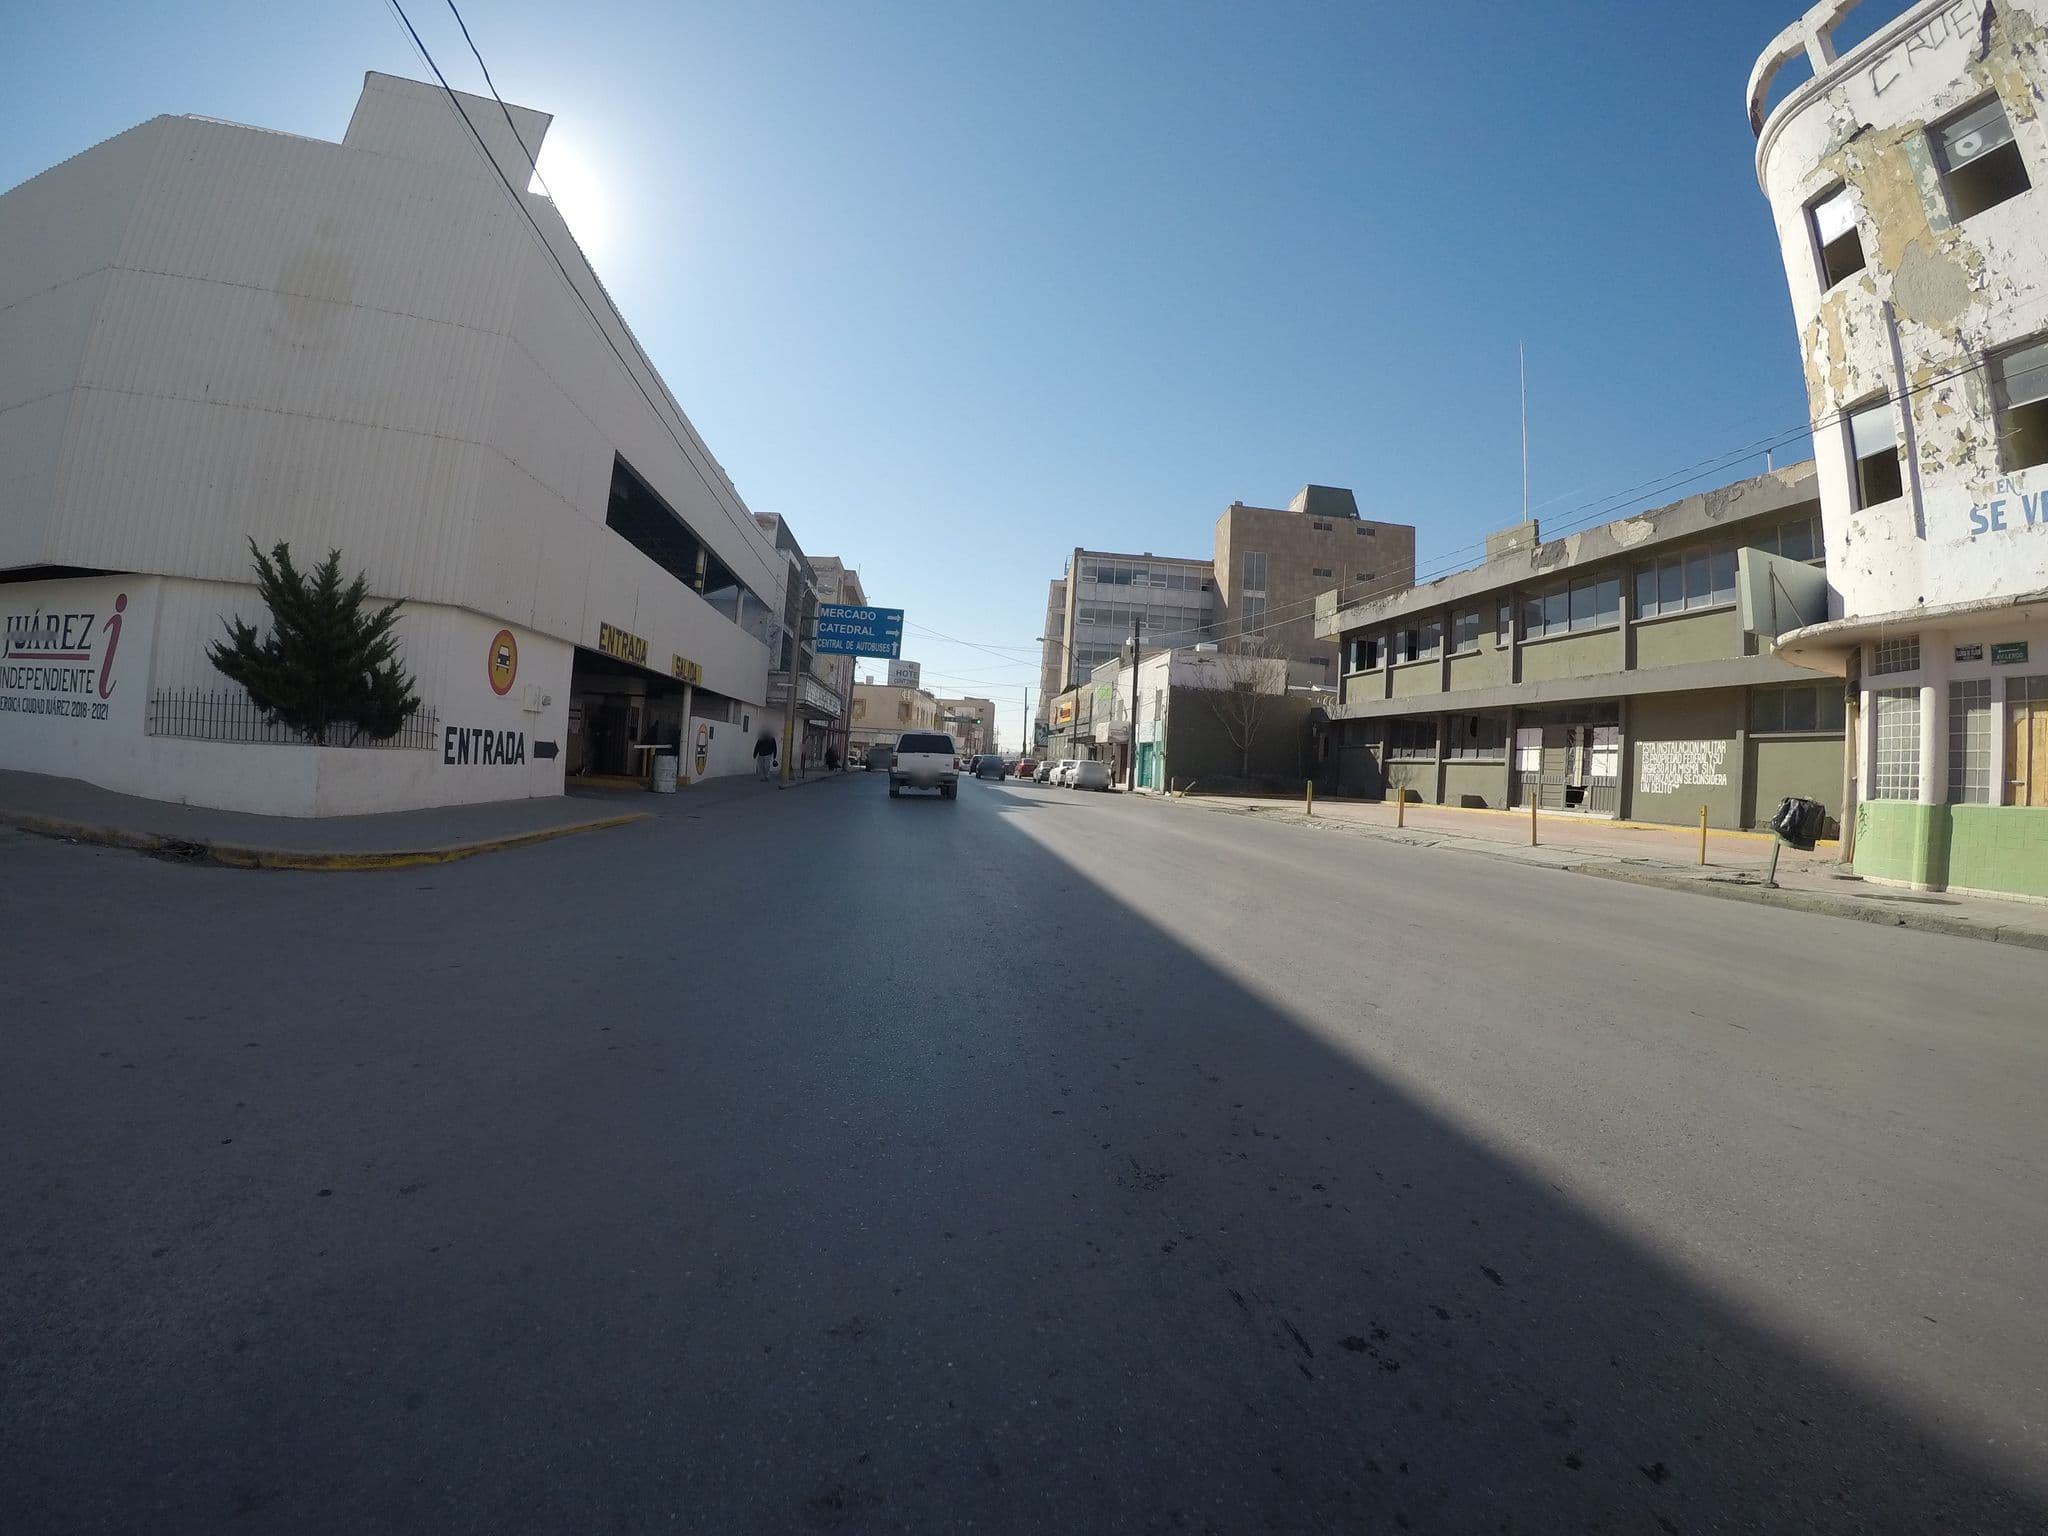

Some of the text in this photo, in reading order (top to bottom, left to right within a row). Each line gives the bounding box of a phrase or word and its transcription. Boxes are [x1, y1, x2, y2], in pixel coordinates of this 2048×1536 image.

[1996, 476, 2022, 496] EN
[1969, 500, 2008, 535] SE
[820, 607, 877, 621] MERCADO
[819, 622, 875, 636] CATEDRAL
[599, 621, 649, 666] ENTRADA
[817, 638, 891, 653] CENTRAL DE AUTOBUSES
[71, 701, 88, 718] 2018
[91, 702, 109, 721] 2021
[443, 726, 525, 766] ENTRADA
[1700, 740, 1727, 754] MILITAR
[1650, 753, 1682, 764] PROPIEDAD
[1683, 753, 1708, 764] FEDERAL
[1713, 752, 1724, 765] SU
[1678, 763, 1699, 774] MISMA
[1701, 763, 1716, 775] SIN
[1683, 774, 1692, 785] SE
[1692, 774, 1727, 786] CONSIDERA
[1640, 782, 1650, 793] UN
